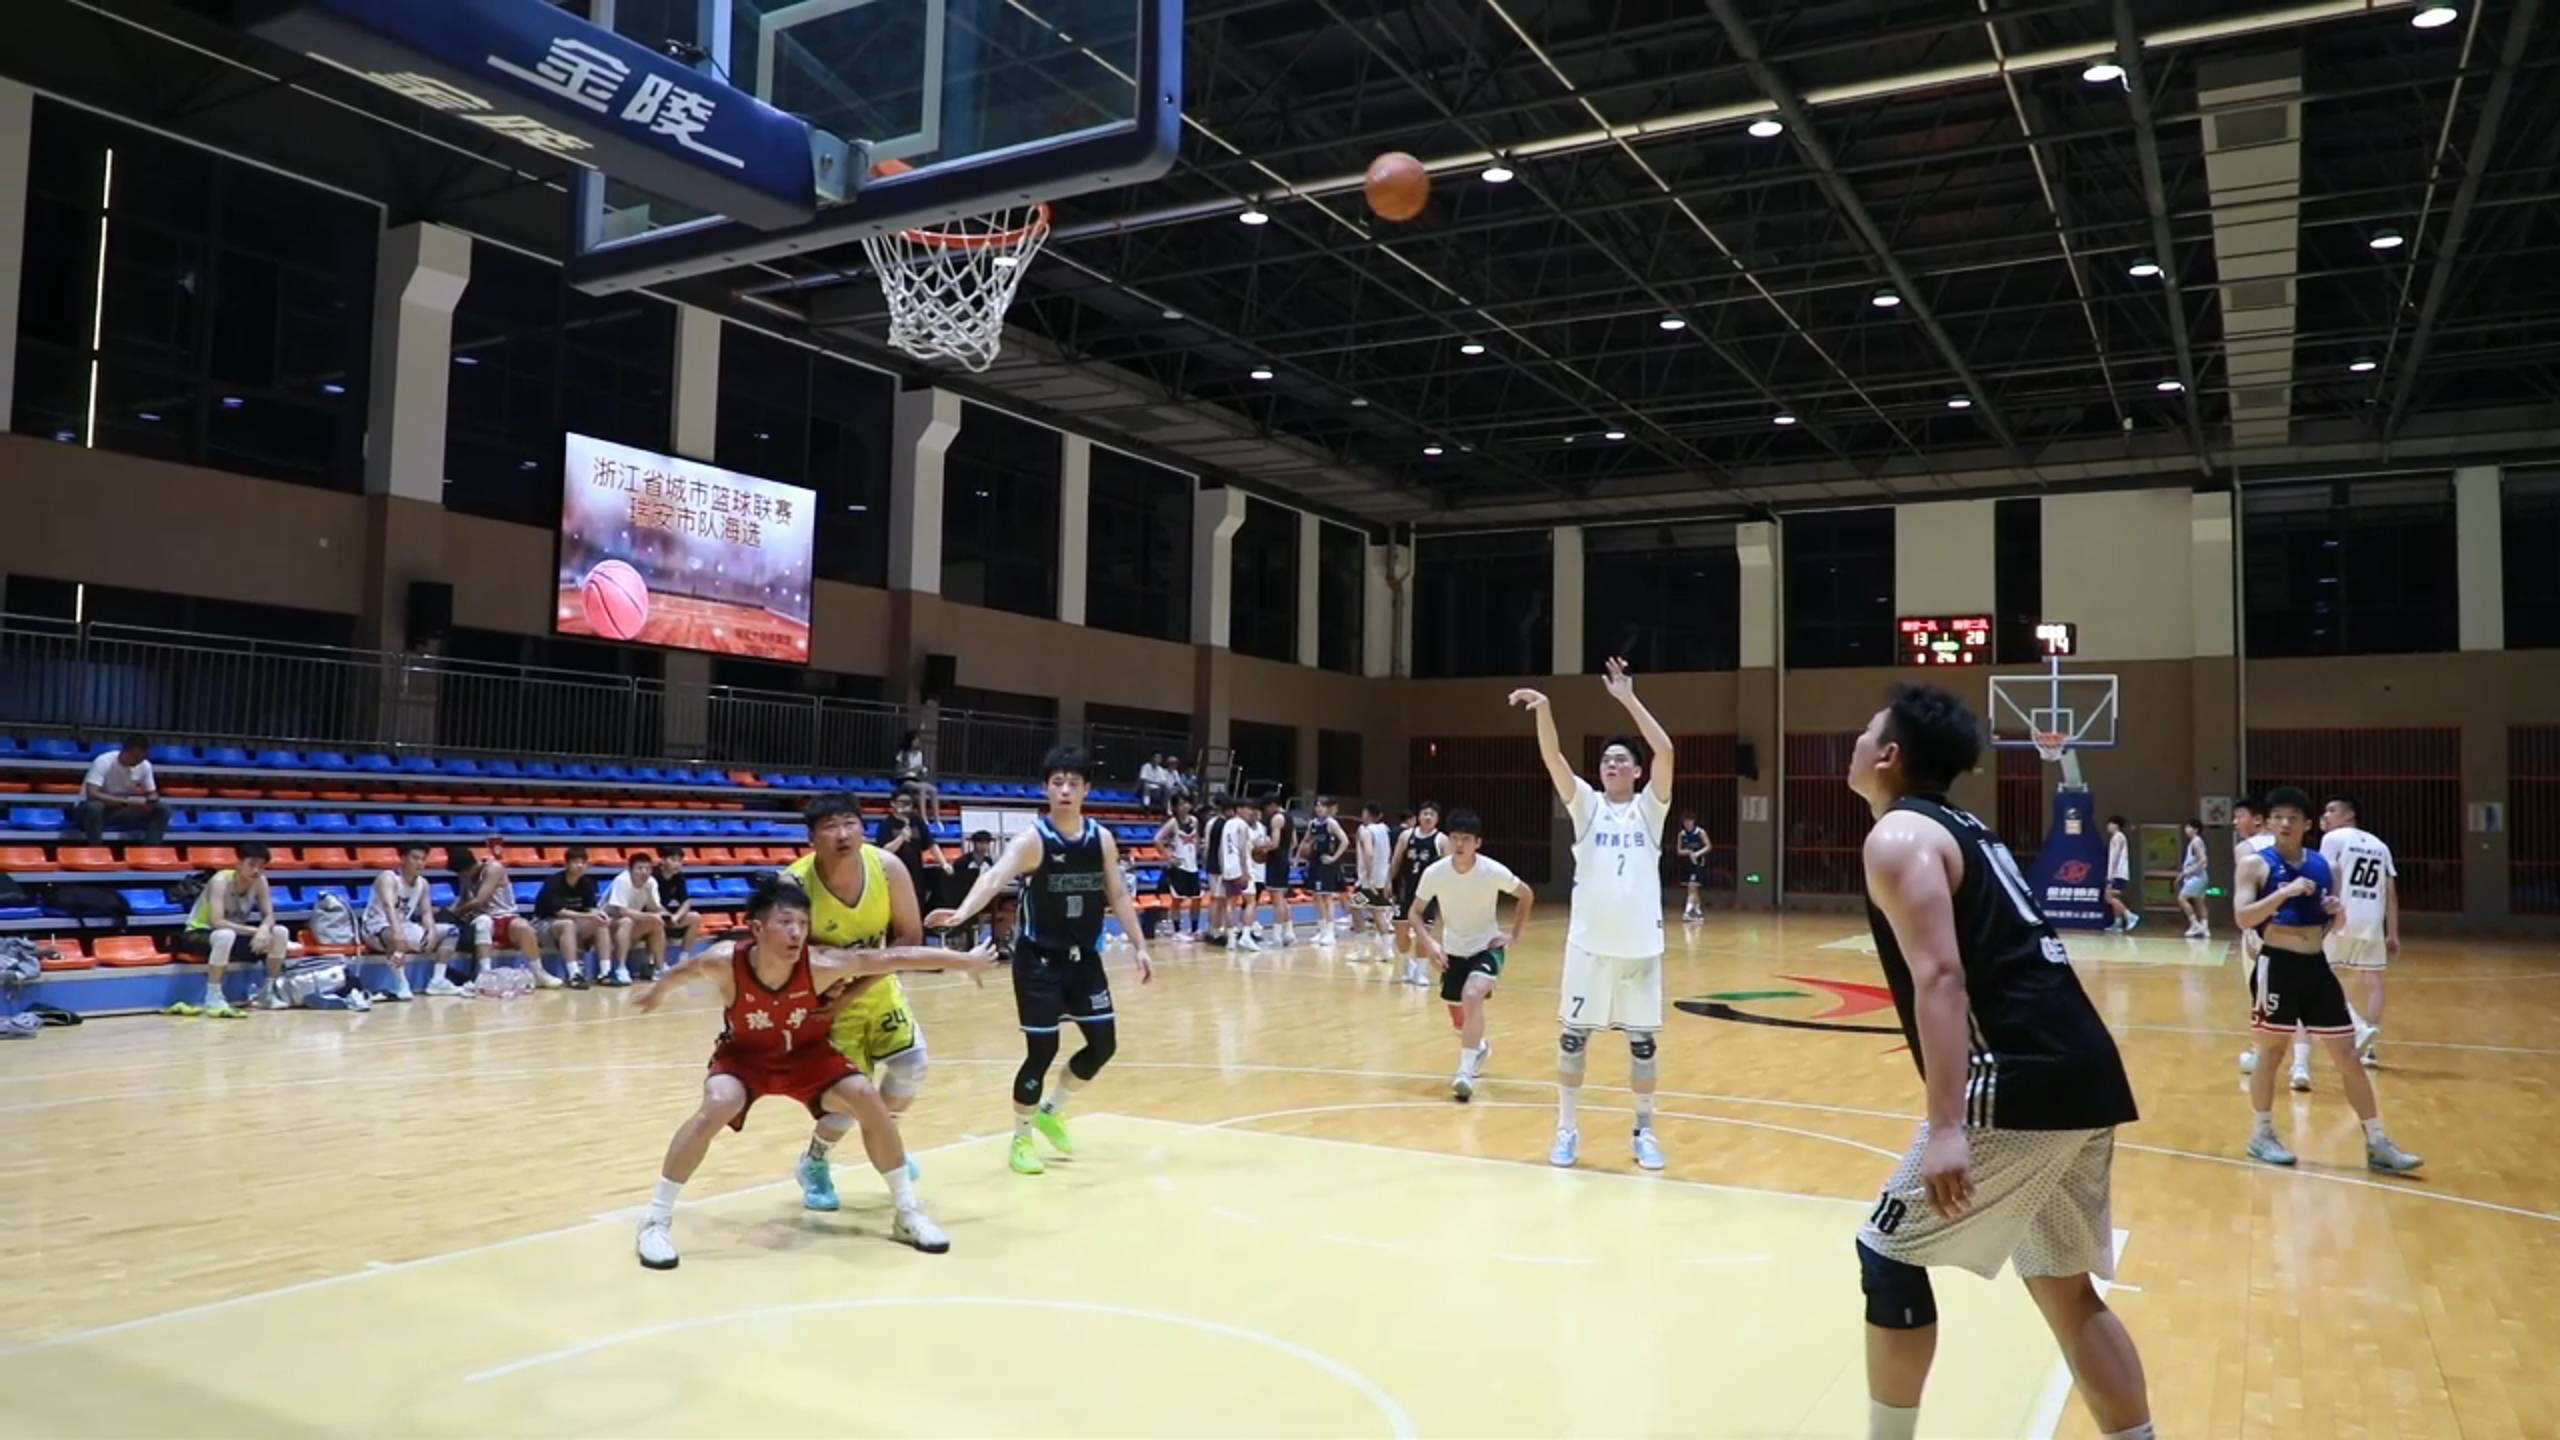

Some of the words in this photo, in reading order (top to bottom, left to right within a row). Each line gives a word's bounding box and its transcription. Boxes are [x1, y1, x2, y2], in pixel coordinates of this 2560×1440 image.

[487, 37, 745, 169] 金陵
[592, 456, 793, 527] 浙江省城市篮球联赛
[628, 496, 762, 549] 瑞安市队海选
[1617, 854, 1626, 876] 7
[2350, 857, 2381, 888] 66
[881, 1008, 908, 1032] 24
[1572, 997, 1585, 1018] 7
[782, 1029, 793, 1051] 1
[1871, 1191, 1907, 1234] 18
